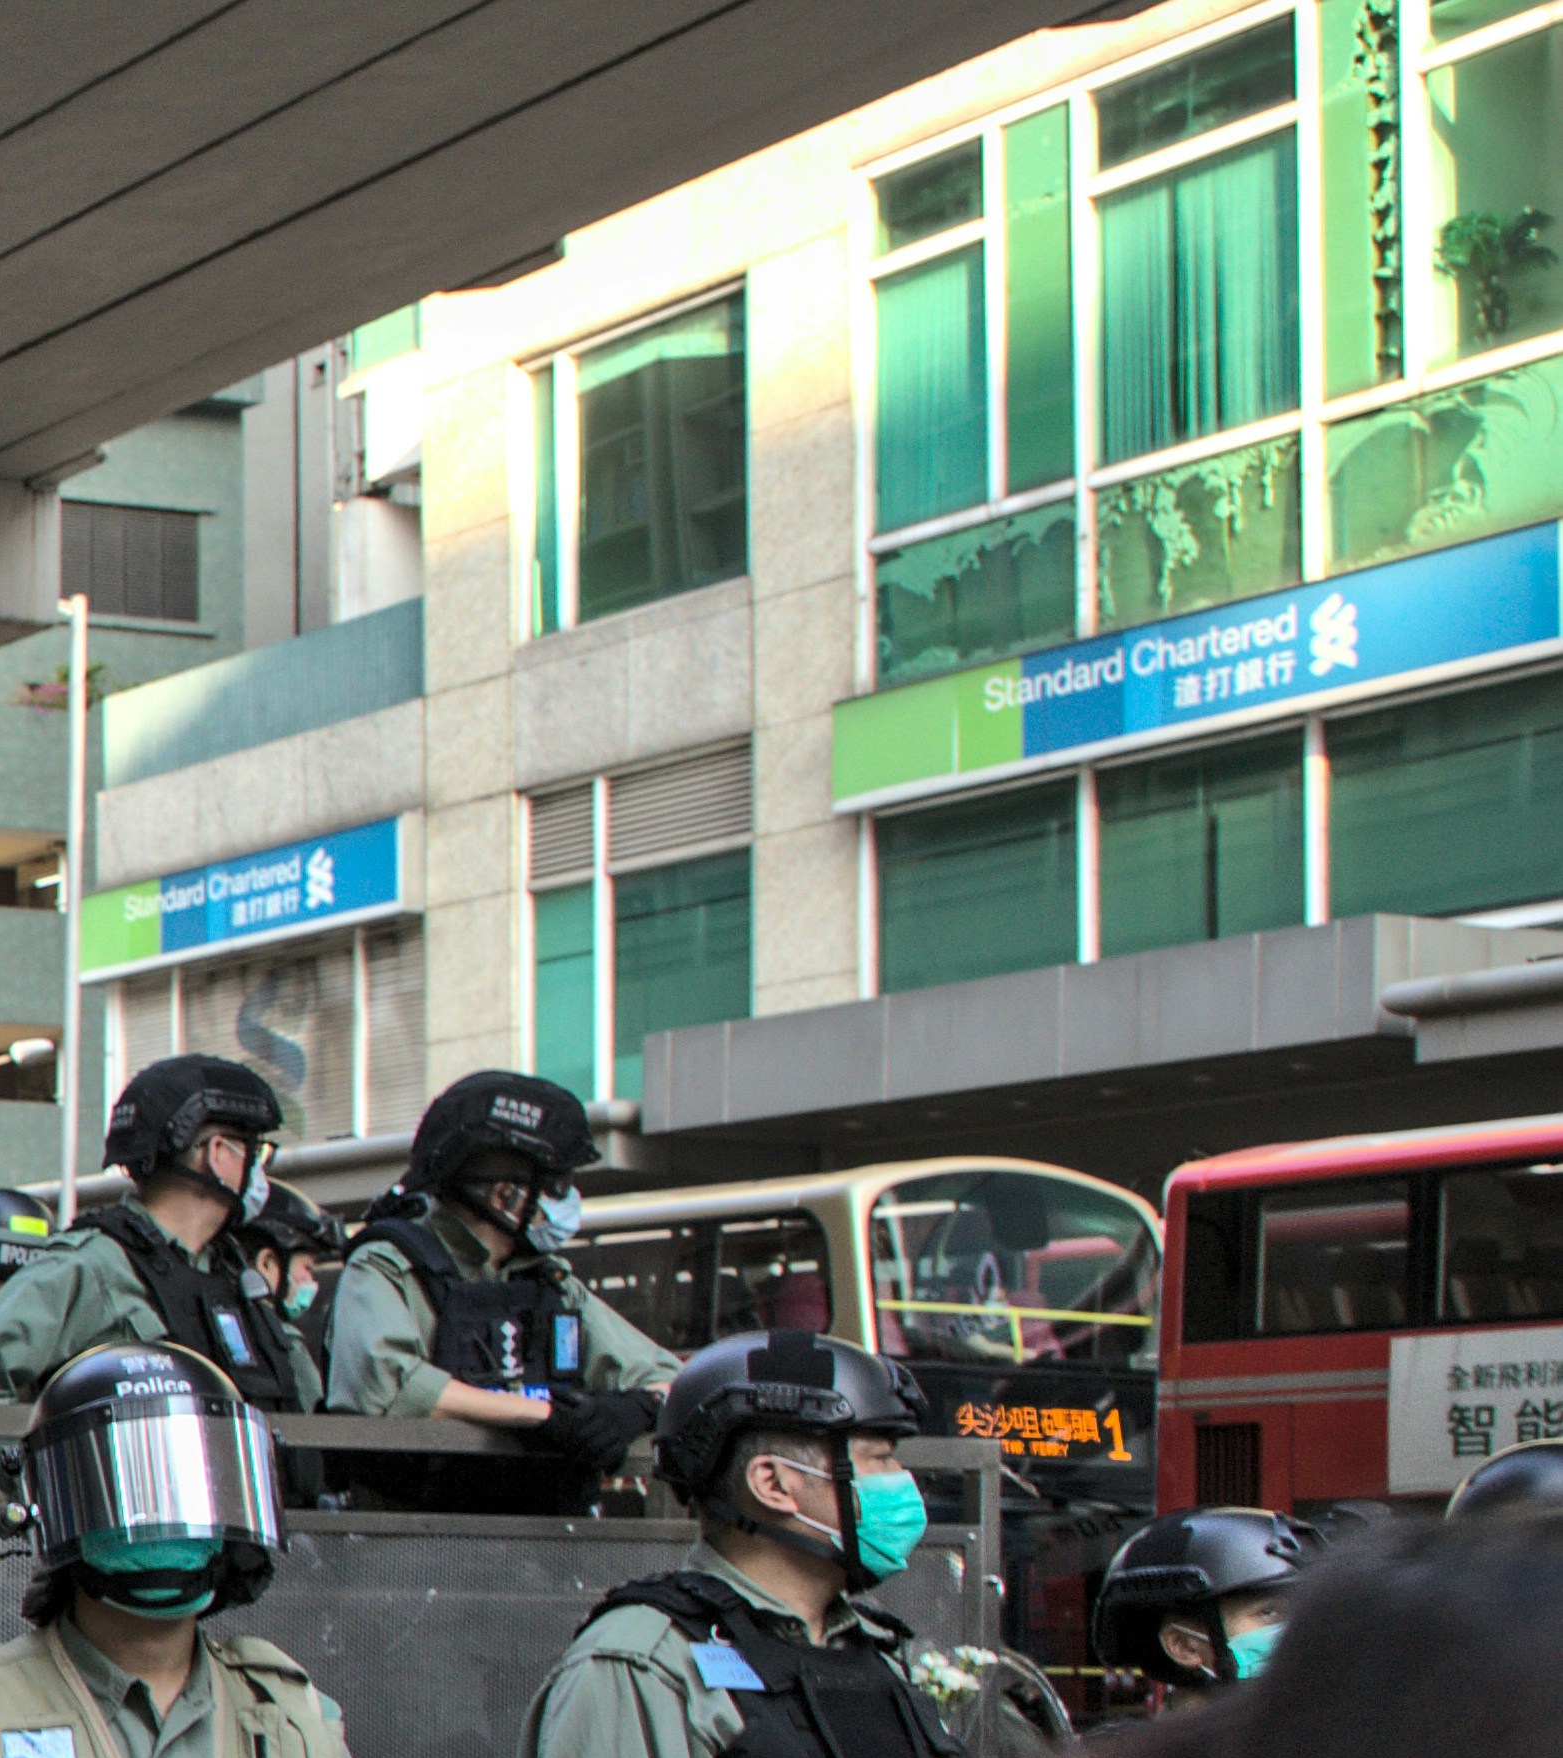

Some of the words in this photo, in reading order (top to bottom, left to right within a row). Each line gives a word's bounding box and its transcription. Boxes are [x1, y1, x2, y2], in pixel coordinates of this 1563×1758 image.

[983, 647, 1125, 711] Standard
[1130, 603, 1298, 676] Chartered
[1173, 650, 1296, 709] 渣打銀行
[124, 879, 205, 921] Standard
[207, 853, 302, 900] Chartered
[1103, 1408, 1132, 1461] 1
